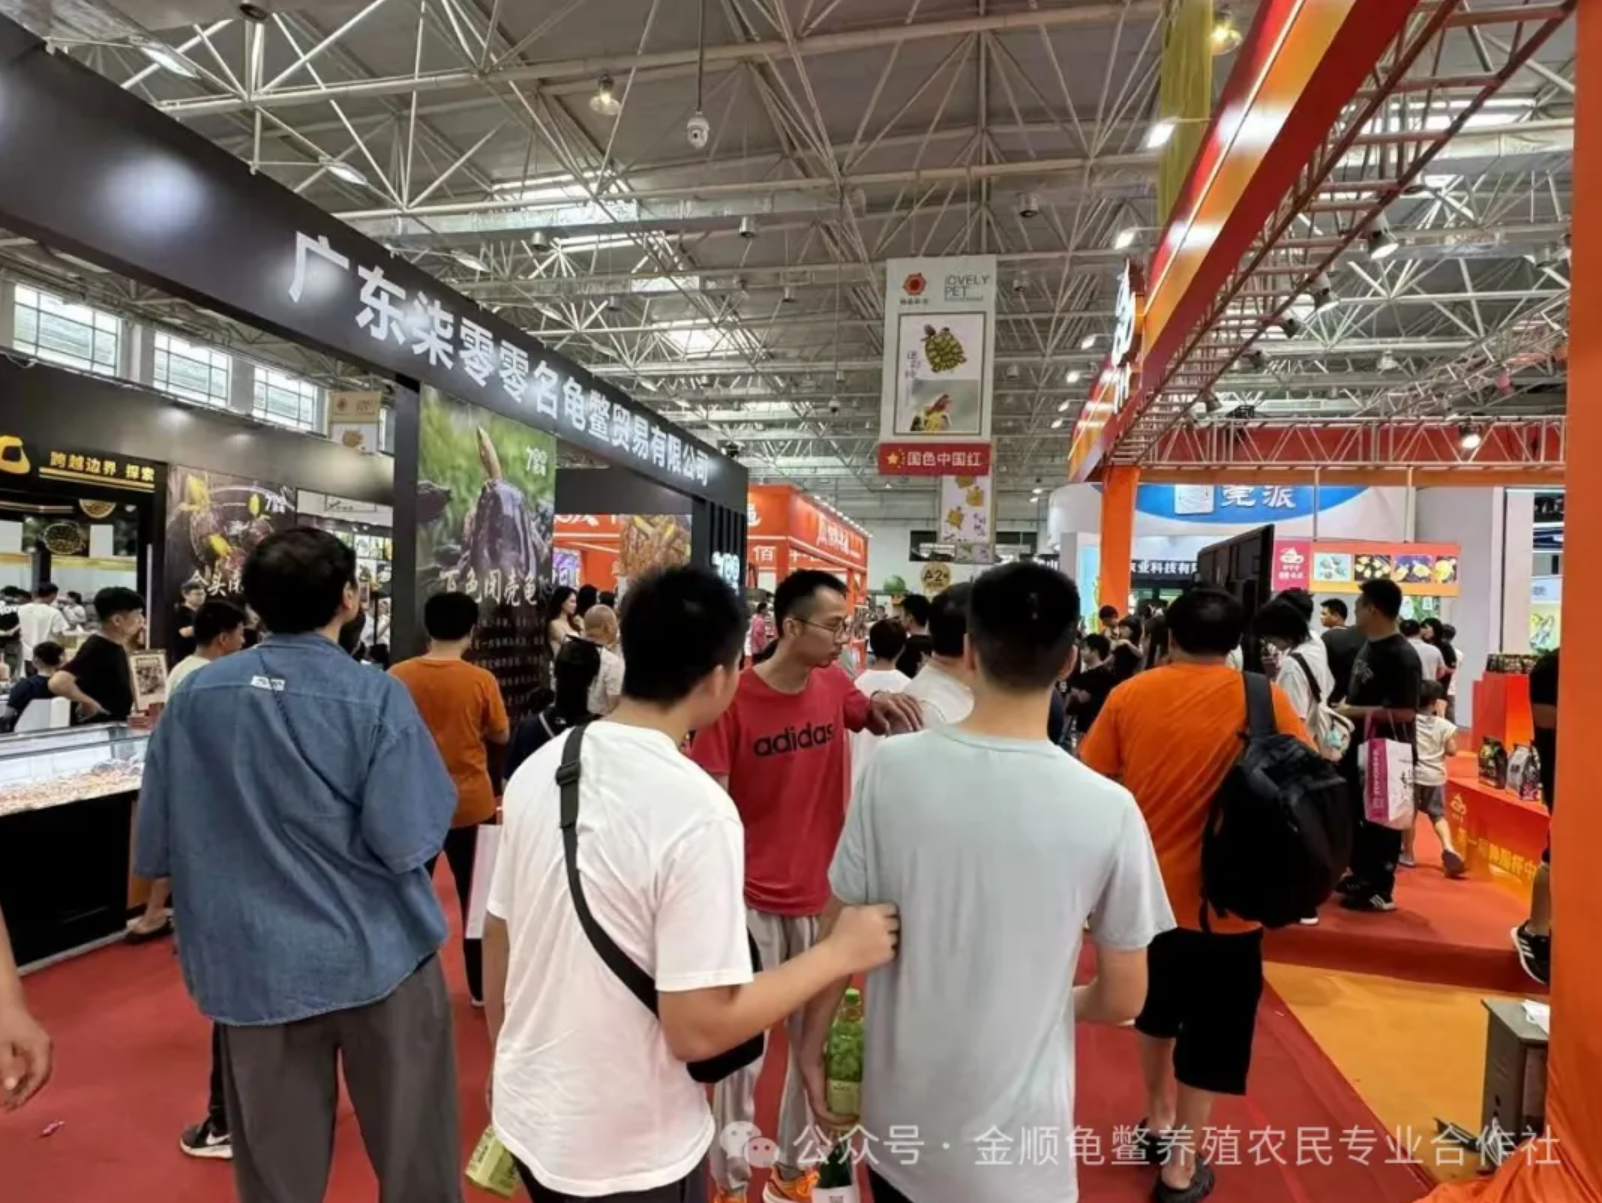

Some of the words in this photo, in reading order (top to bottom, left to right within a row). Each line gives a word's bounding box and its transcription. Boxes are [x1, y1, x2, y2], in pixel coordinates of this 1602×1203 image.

[288, 230, 709, 487] 广东柒零零名龟鳖贸易有限公司
[1220, 484, 1297, 509] 莞派
[753, 720, 835, 758] adidas
